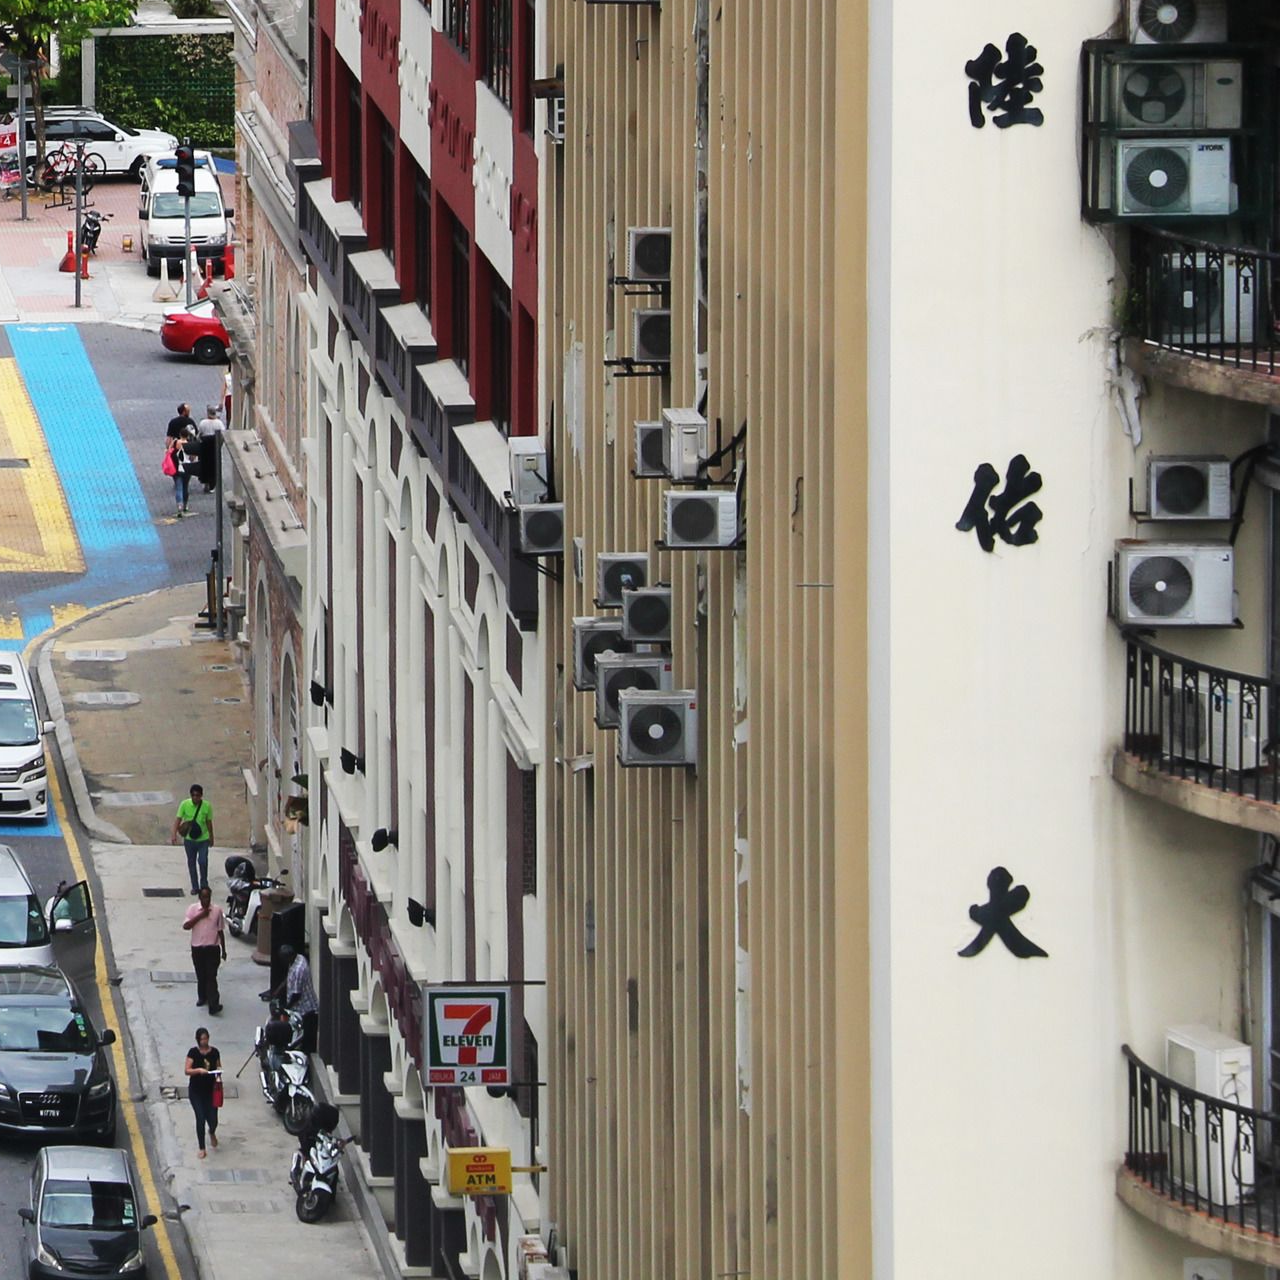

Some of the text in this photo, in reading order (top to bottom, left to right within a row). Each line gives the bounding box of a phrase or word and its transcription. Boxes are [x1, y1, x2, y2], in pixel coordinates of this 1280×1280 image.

[443, 1004, 492, 1065] 7
[460, 1071, 476, 1082] 24
[466, 1174, 496, 1185] ATM
